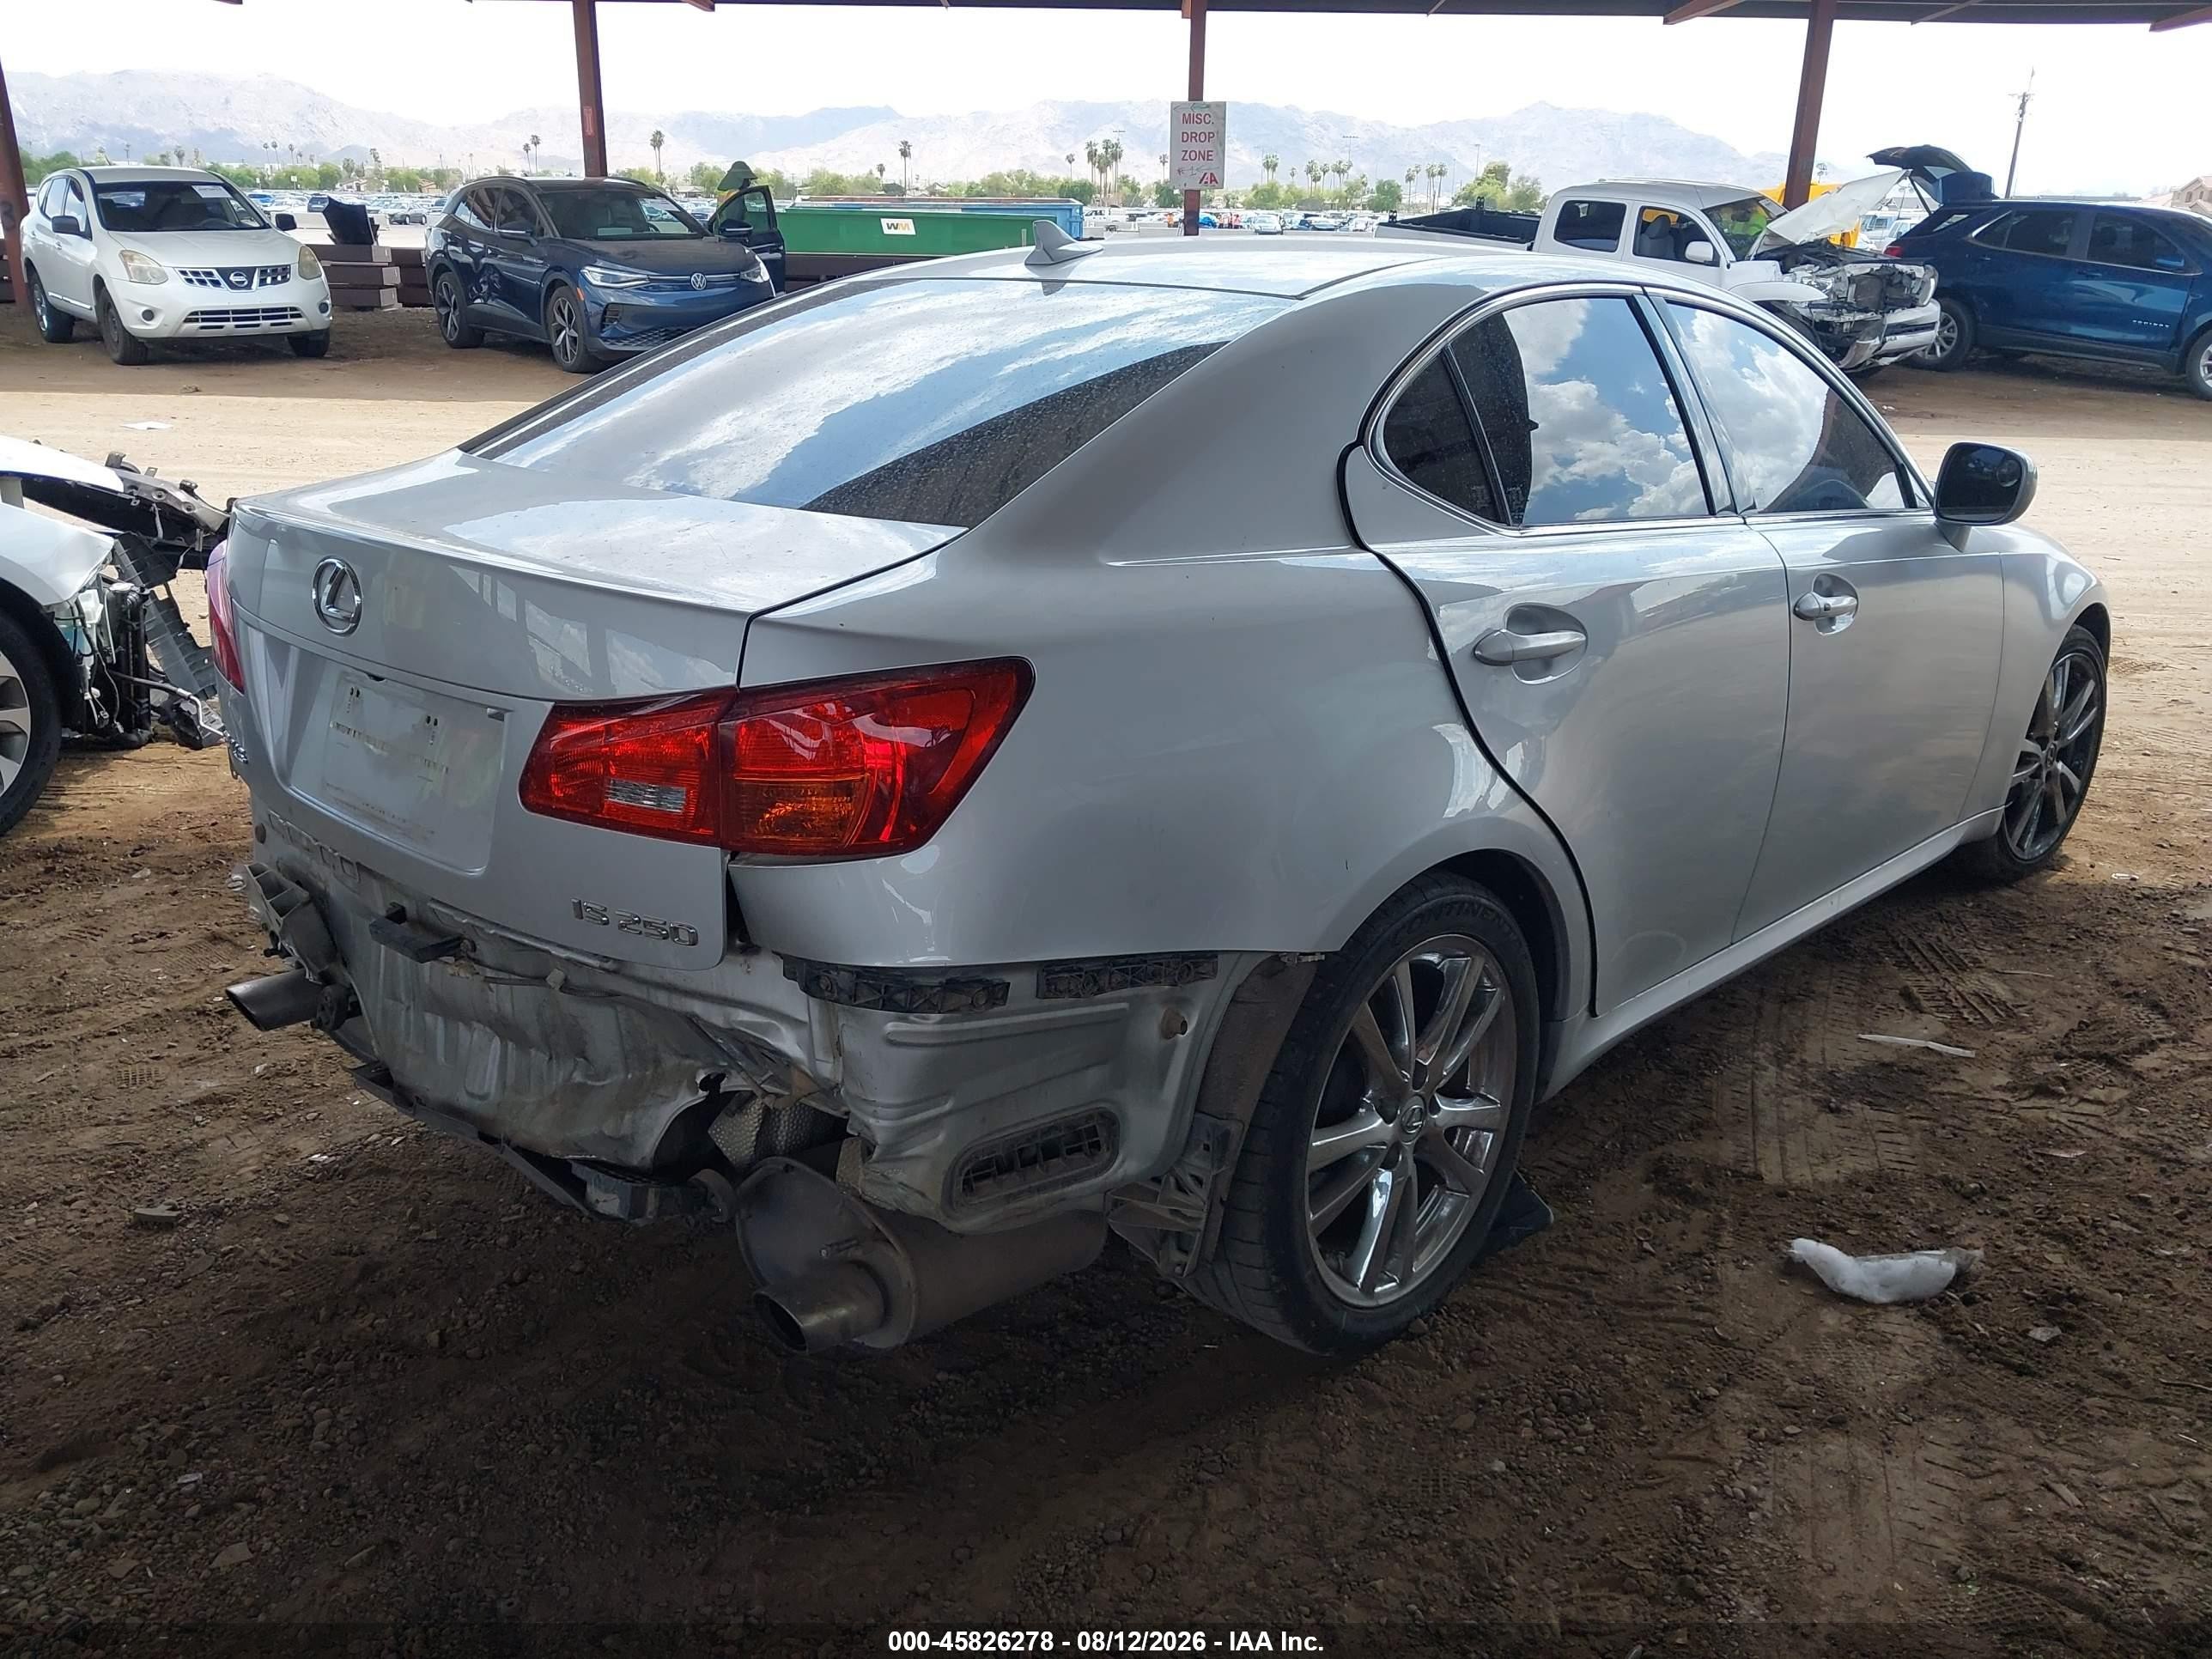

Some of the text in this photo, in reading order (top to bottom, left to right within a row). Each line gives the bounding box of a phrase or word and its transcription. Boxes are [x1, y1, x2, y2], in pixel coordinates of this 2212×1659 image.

[1182, 112, 1214, 125] MISC.
[1181, 131, 1215, 143] DROP
[1181, 149, 1214, 161] ZONE
[886, 222, 911, 231] WM
[570, 896, 699, 947] IS 250
